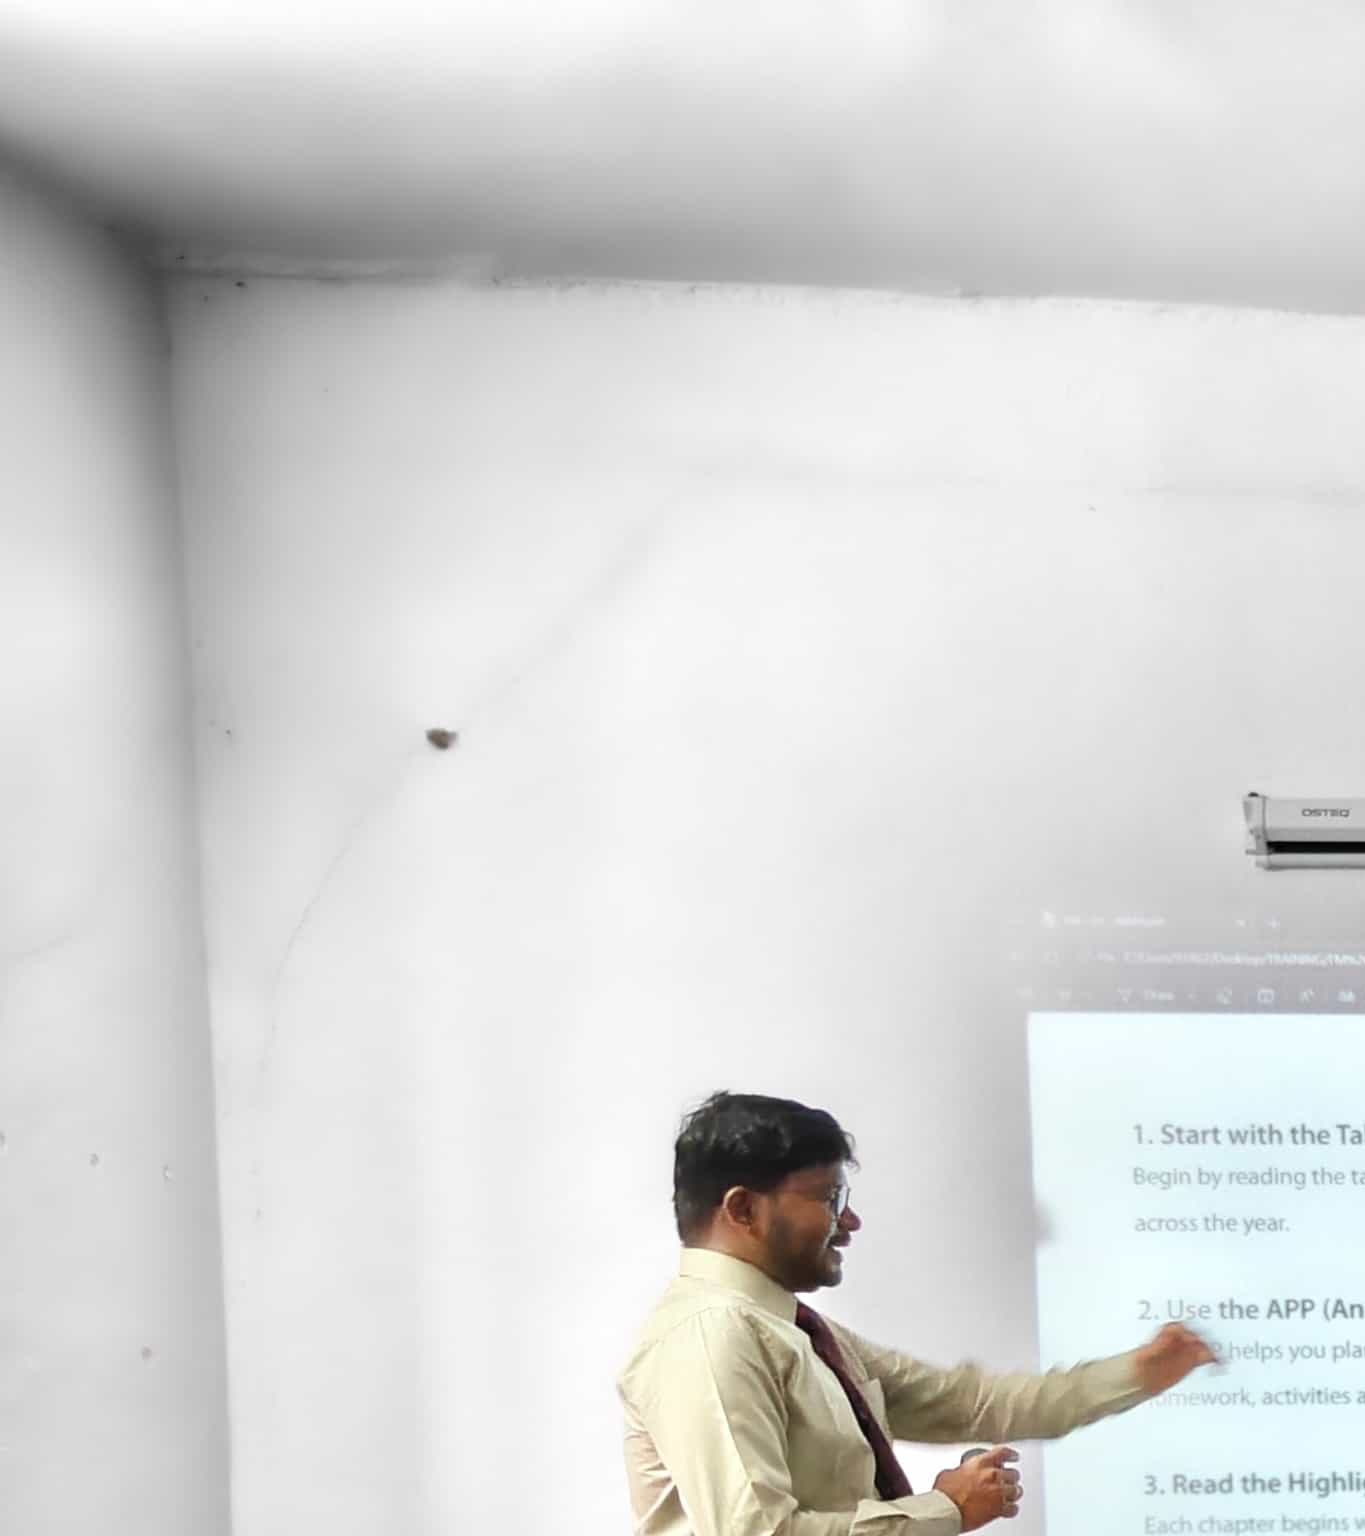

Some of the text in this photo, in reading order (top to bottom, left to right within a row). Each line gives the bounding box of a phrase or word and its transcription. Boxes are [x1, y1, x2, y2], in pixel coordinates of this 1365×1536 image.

[1132, 1123, 1155, 1146] 1.
[1160, 1123, 1222, 1145] Start
[1226, 1123, 1284, 1146] with
[1290, 1123, 1329, 1146] the
[1132, 1165, 1193, 1191] Begin
[1196, 1167, 1224, 1191] by
[1227, 1165, 1307, 1191] reading
[1310, 1165, 1347, 1186] the
[1133, 1212, 1290, 1237] across the year.
[1138, 1300, 1158, 1321] 2.
[1166, 1299, 1211, 1320] Use
[1217, 1297, 1260, 1321] the
[1265, 1298, 1316, 1321] APP
[1229, 1340, 1284, 1363] helps
[1288, 1344, 1327, 1365] you
[1148, 1386, 1257, 1407] omework,
[1261, 1386, 1353, 1406] activities
[1143, 1474, 1166, 1496] 3.
[1172, 1472, 1235, 1495] Read
[1239, 1471, 1283, 1495] the
[1144, 1511, 1194, 1536] Each
[1280, 1512, 1351, 1536] begins
